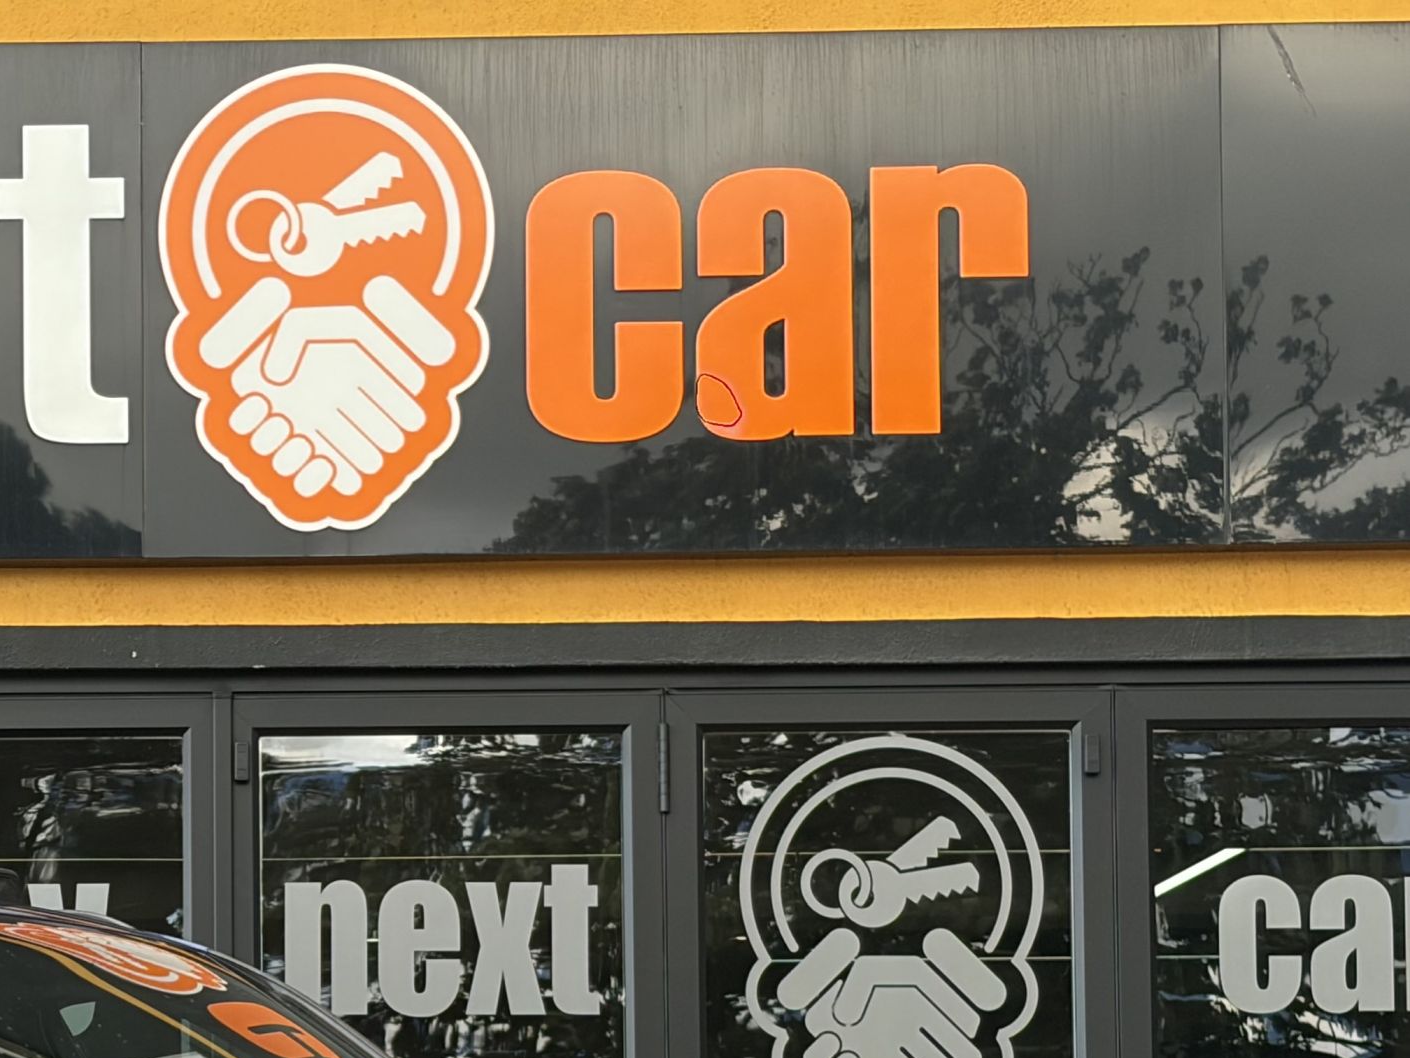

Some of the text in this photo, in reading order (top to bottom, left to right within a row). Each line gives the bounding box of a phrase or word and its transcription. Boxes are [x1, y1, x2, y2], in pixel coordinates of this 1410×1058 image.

[526, 163, 1029, 442] car
[284, 863, 1410, 1017] next ca
